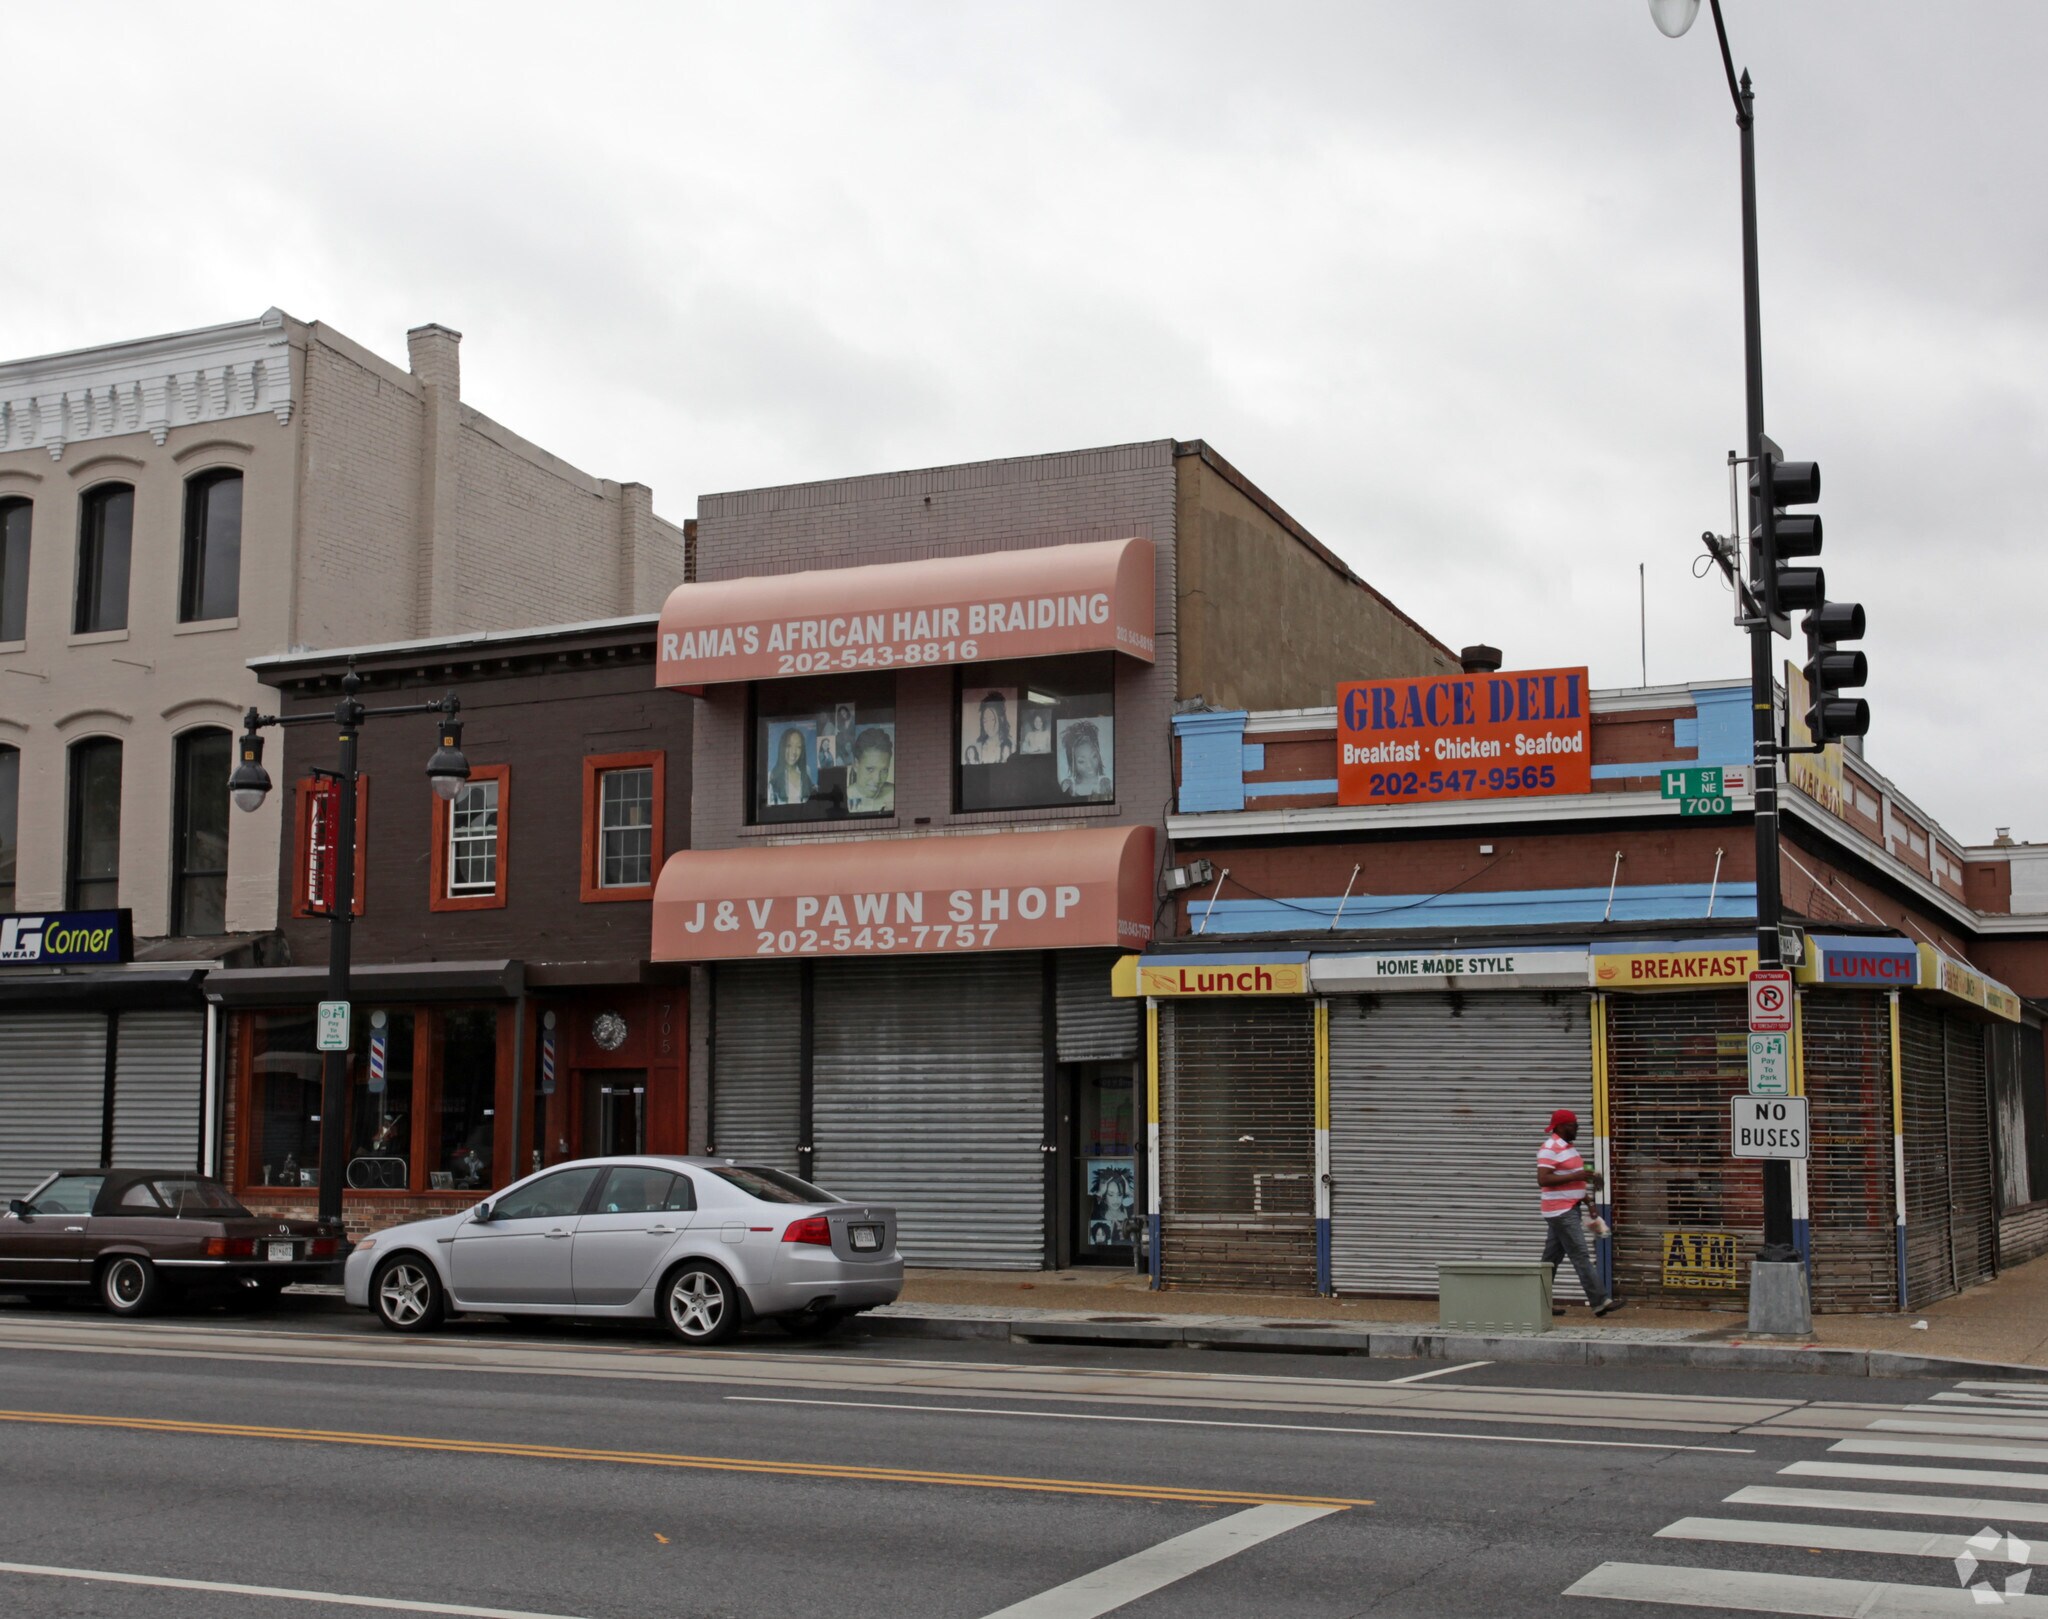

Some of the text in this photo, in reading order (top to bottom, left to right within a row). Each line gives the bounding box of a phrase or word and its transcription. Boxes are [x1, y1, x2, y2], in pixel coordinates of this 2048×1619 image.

[662, 593, 1109, 662] RAMA'S AFRICAN HAIR BRAIDING
[778, 639, 978, 674] 202-543-8816
[1343, 674, 1581, 732] GRACE DELI
[1343, 730, 1583, 765] Breakfast Chicken Seafood
[1370, 765, 1556, 796] 202-547-9565
[1667, 771, 1716, 795] H ST
[1701, 783, 1717, 793] NE
[1686, 797, 1725, 814] 700
[797, 891, 923, 928] PAWN
[948, 885, 1081, 923] SHOP
[45, 922, 113, 954] Corner
[757, 923, 999, 954] 202-543-7757
[2, 950, 36, 958] WEAR
[1377, 957, 1514, 975] HOME MADE STYLE
[1180, 966, 1272, 992] Lunch
[1631, 956, 1748, 979] BREAKFAST
[1828, 957, 1911, 978] LUNCH
[1761, 1057, 1775, 1065] Pay
[1756, 1103, 1786, 1121] NO
[1741, 1128, 1800, 1147] BUSES
[1667, 1234, 1734, 1268] ATM
